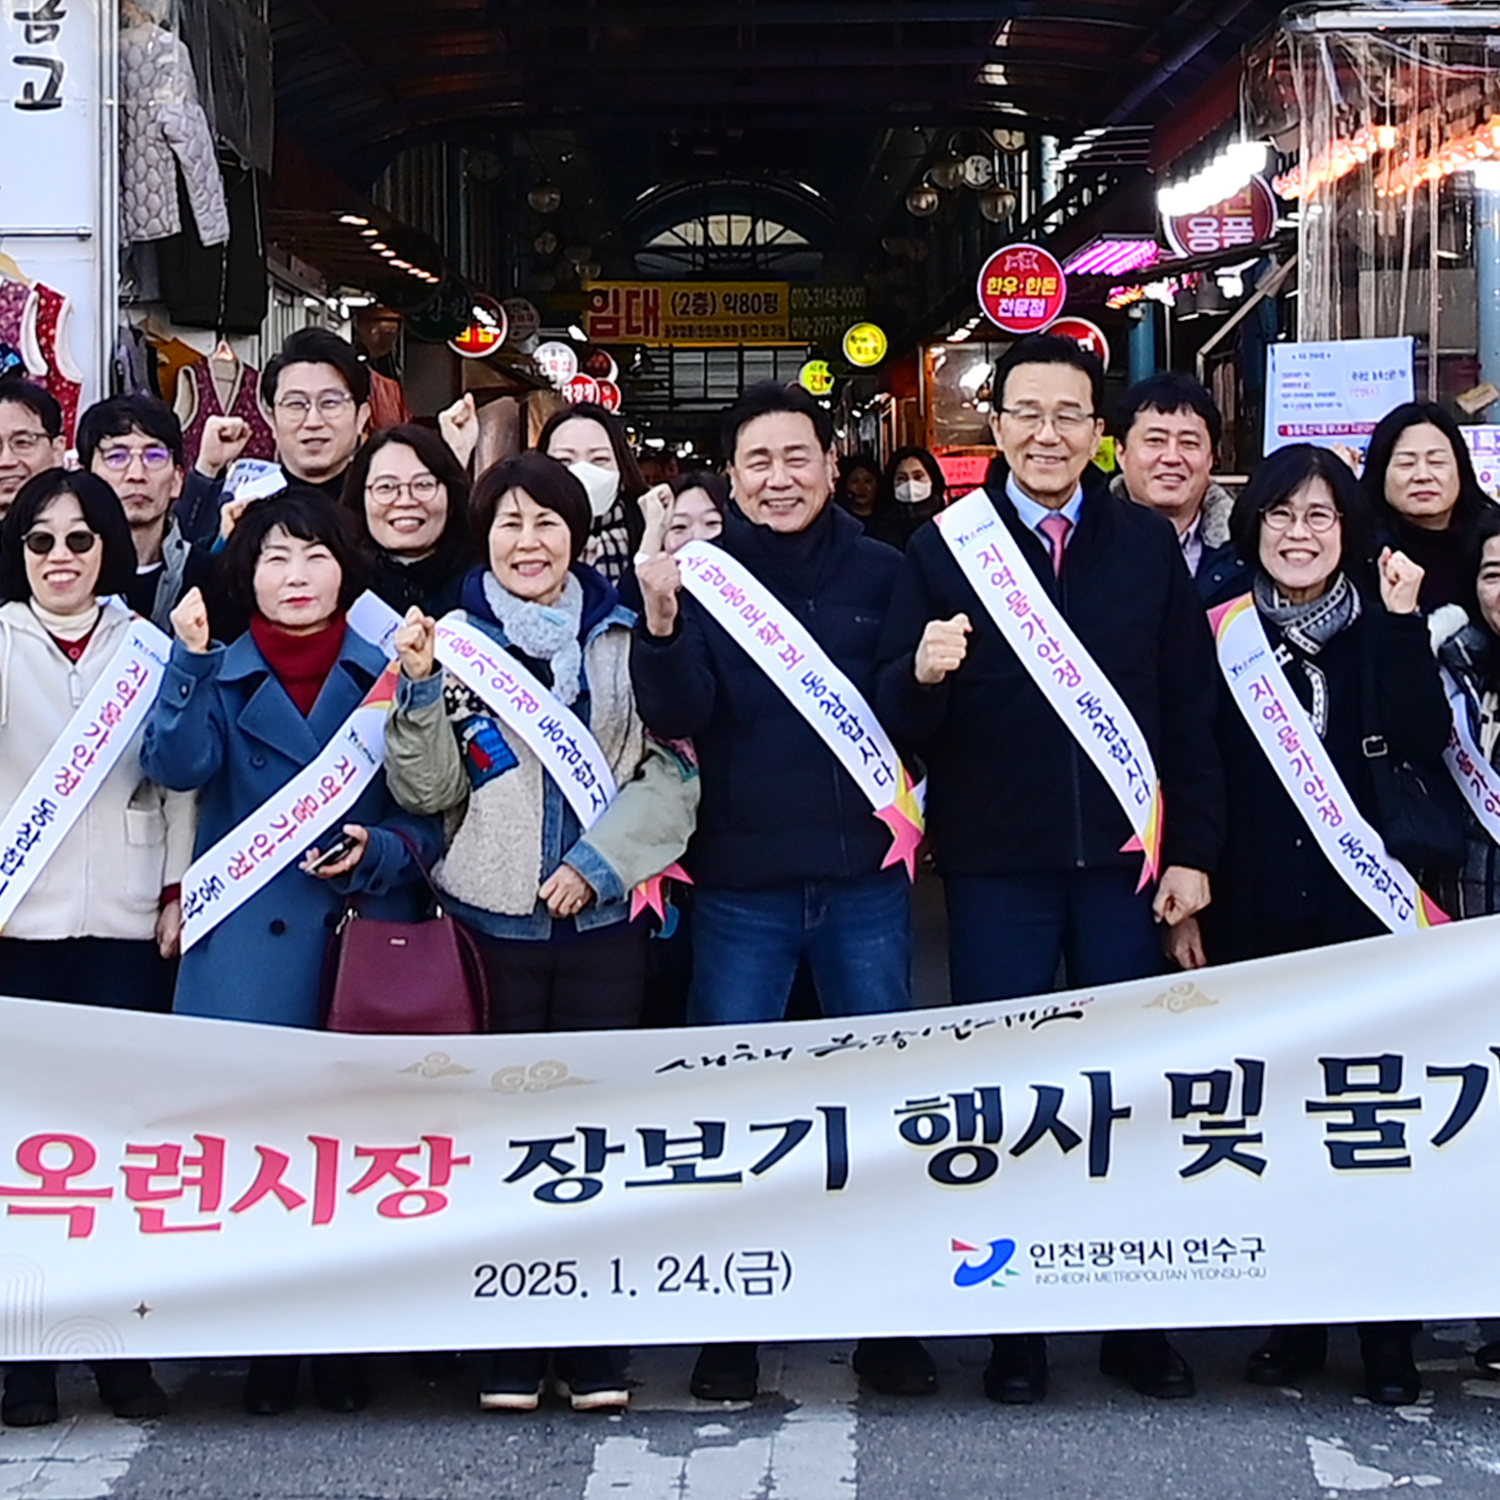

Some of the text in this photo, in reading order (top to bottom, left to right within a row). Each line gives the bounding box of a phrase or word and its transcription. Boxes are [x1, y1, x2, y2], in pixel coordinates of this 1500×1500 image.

[588, 288, 662, 338] 임대
[52, 659, 153, 799] 지역물가안정
[799, 668, 898, 790] 동참합시다
[976, 541, 1152, 807] 지역물가안정 동참합시다
[225, 752, 359, 882] 지역물가안정
[1247, 672, 1416, 923] 지역물가안정 동참합시다
[503, 1102, 852, 1206] 장보기
[894, 1069, 1131, 1188] 행사
[1164, 1056, 1270, 1180] 및
[474, 1248, 794, 1300] 2025. 1. 24.(금)
[1029, 1236, 1267, 1270] 인천광역시 연수구
[1034, 1266, 1268, 1285] INCHEON METROPOLITAN YEONSU-GU
